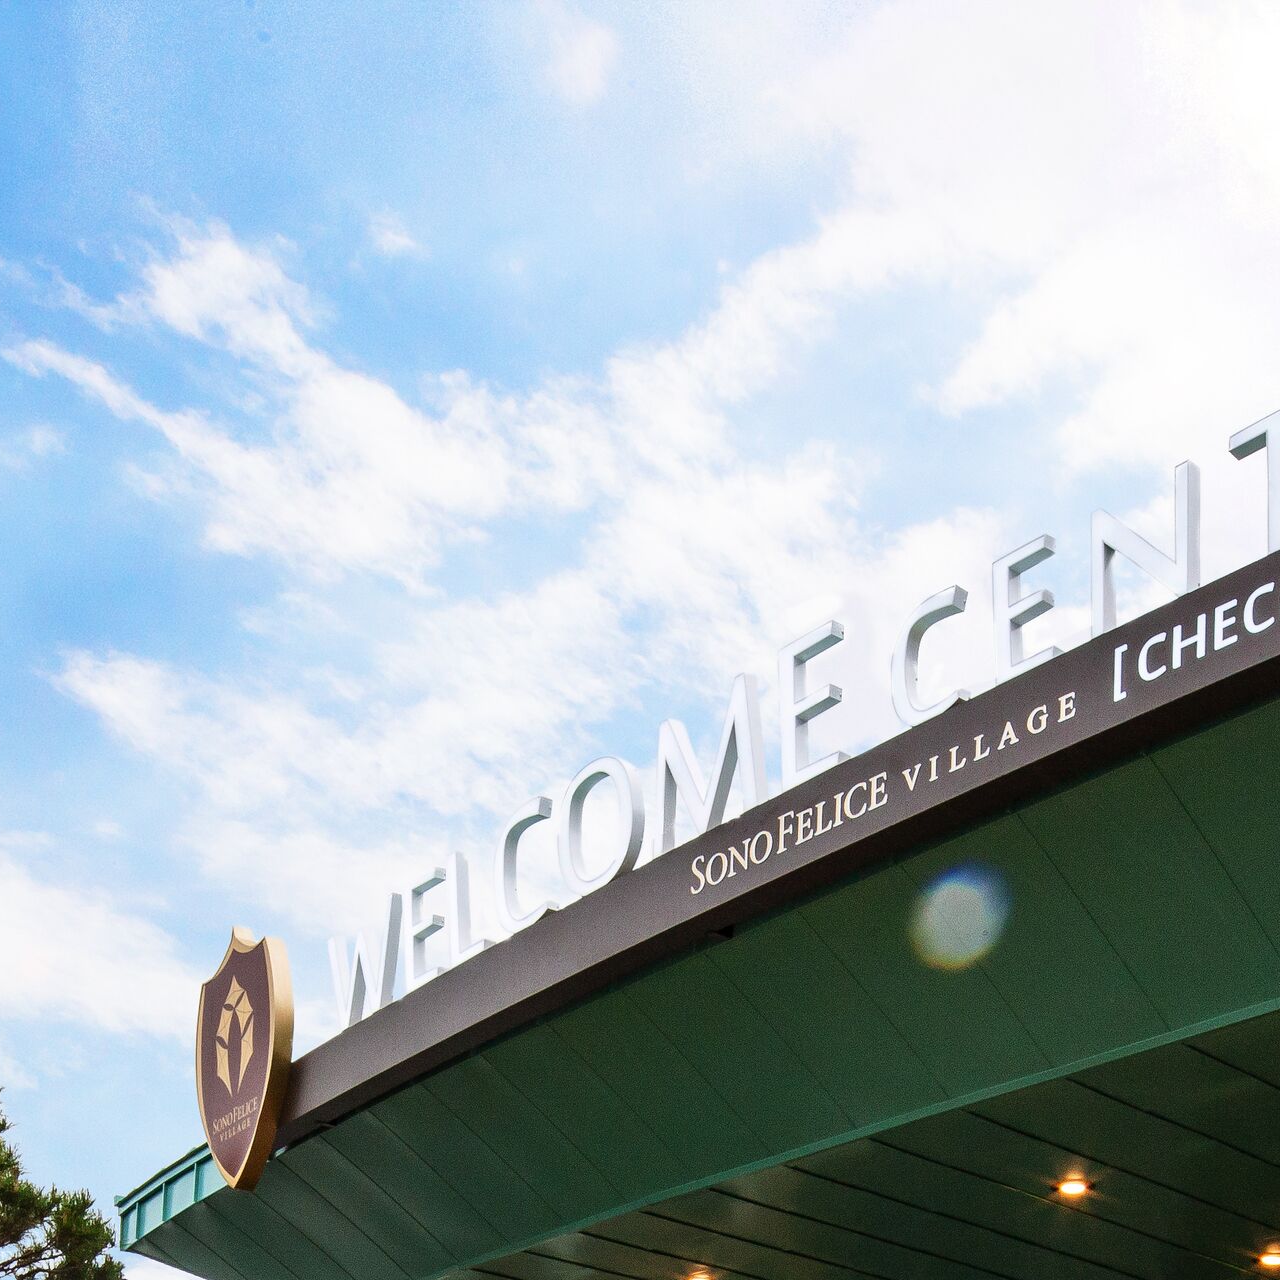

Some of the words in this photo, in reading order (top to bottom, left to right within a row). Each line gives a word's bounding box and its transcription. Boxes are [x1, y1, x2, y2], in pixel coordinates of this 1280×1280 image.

[902, 692, 1077, 792] VILLAGE
[327, 620, 850, 1032] WELCOME
[220, 1117, 252, 1142] VILLAGE
